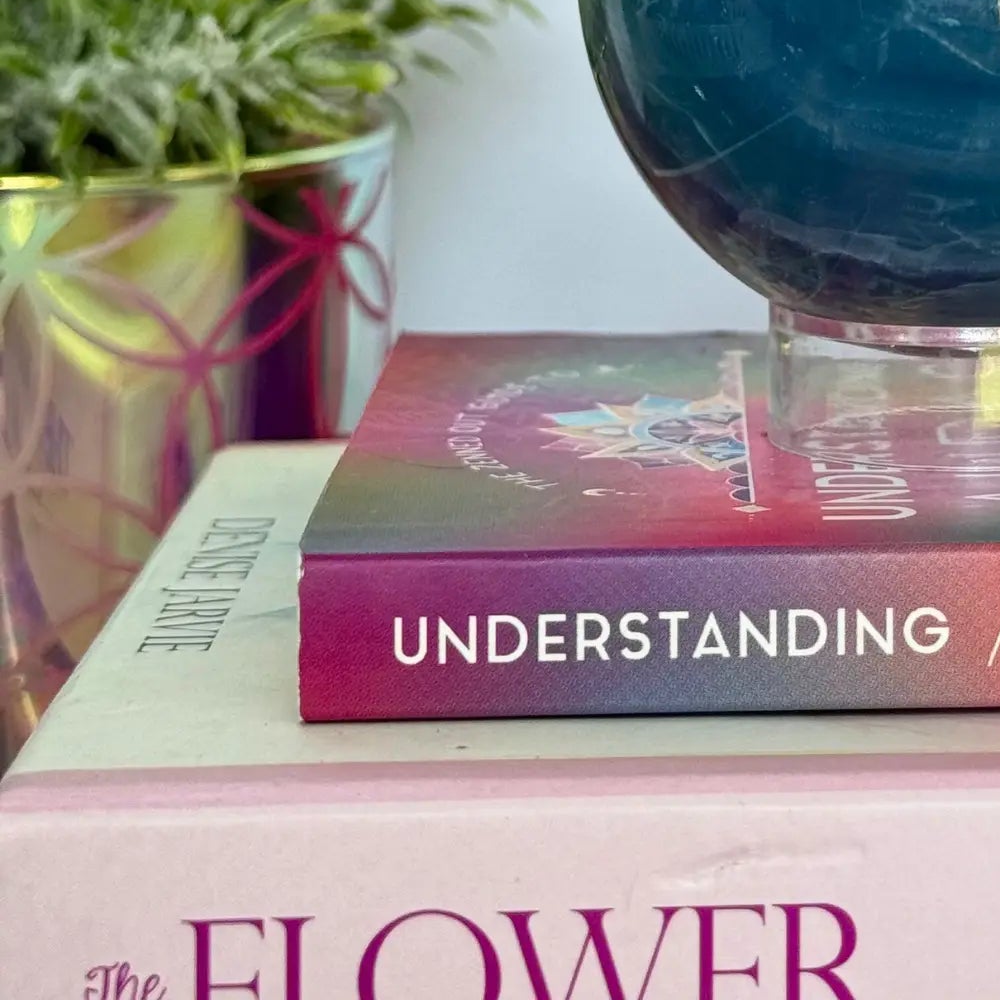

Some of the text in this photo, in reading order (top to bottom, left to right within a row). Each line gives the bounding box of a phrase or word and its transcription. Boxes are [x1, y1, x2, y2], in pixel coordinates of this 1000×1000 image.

[489, 471, 559, 491] THE
[136, 516, 277, 654] DENISE JARVIE
[393, 607, 950, 665] UNDERSTANDING
[84, 902, 858, 1000] The FLOWER
